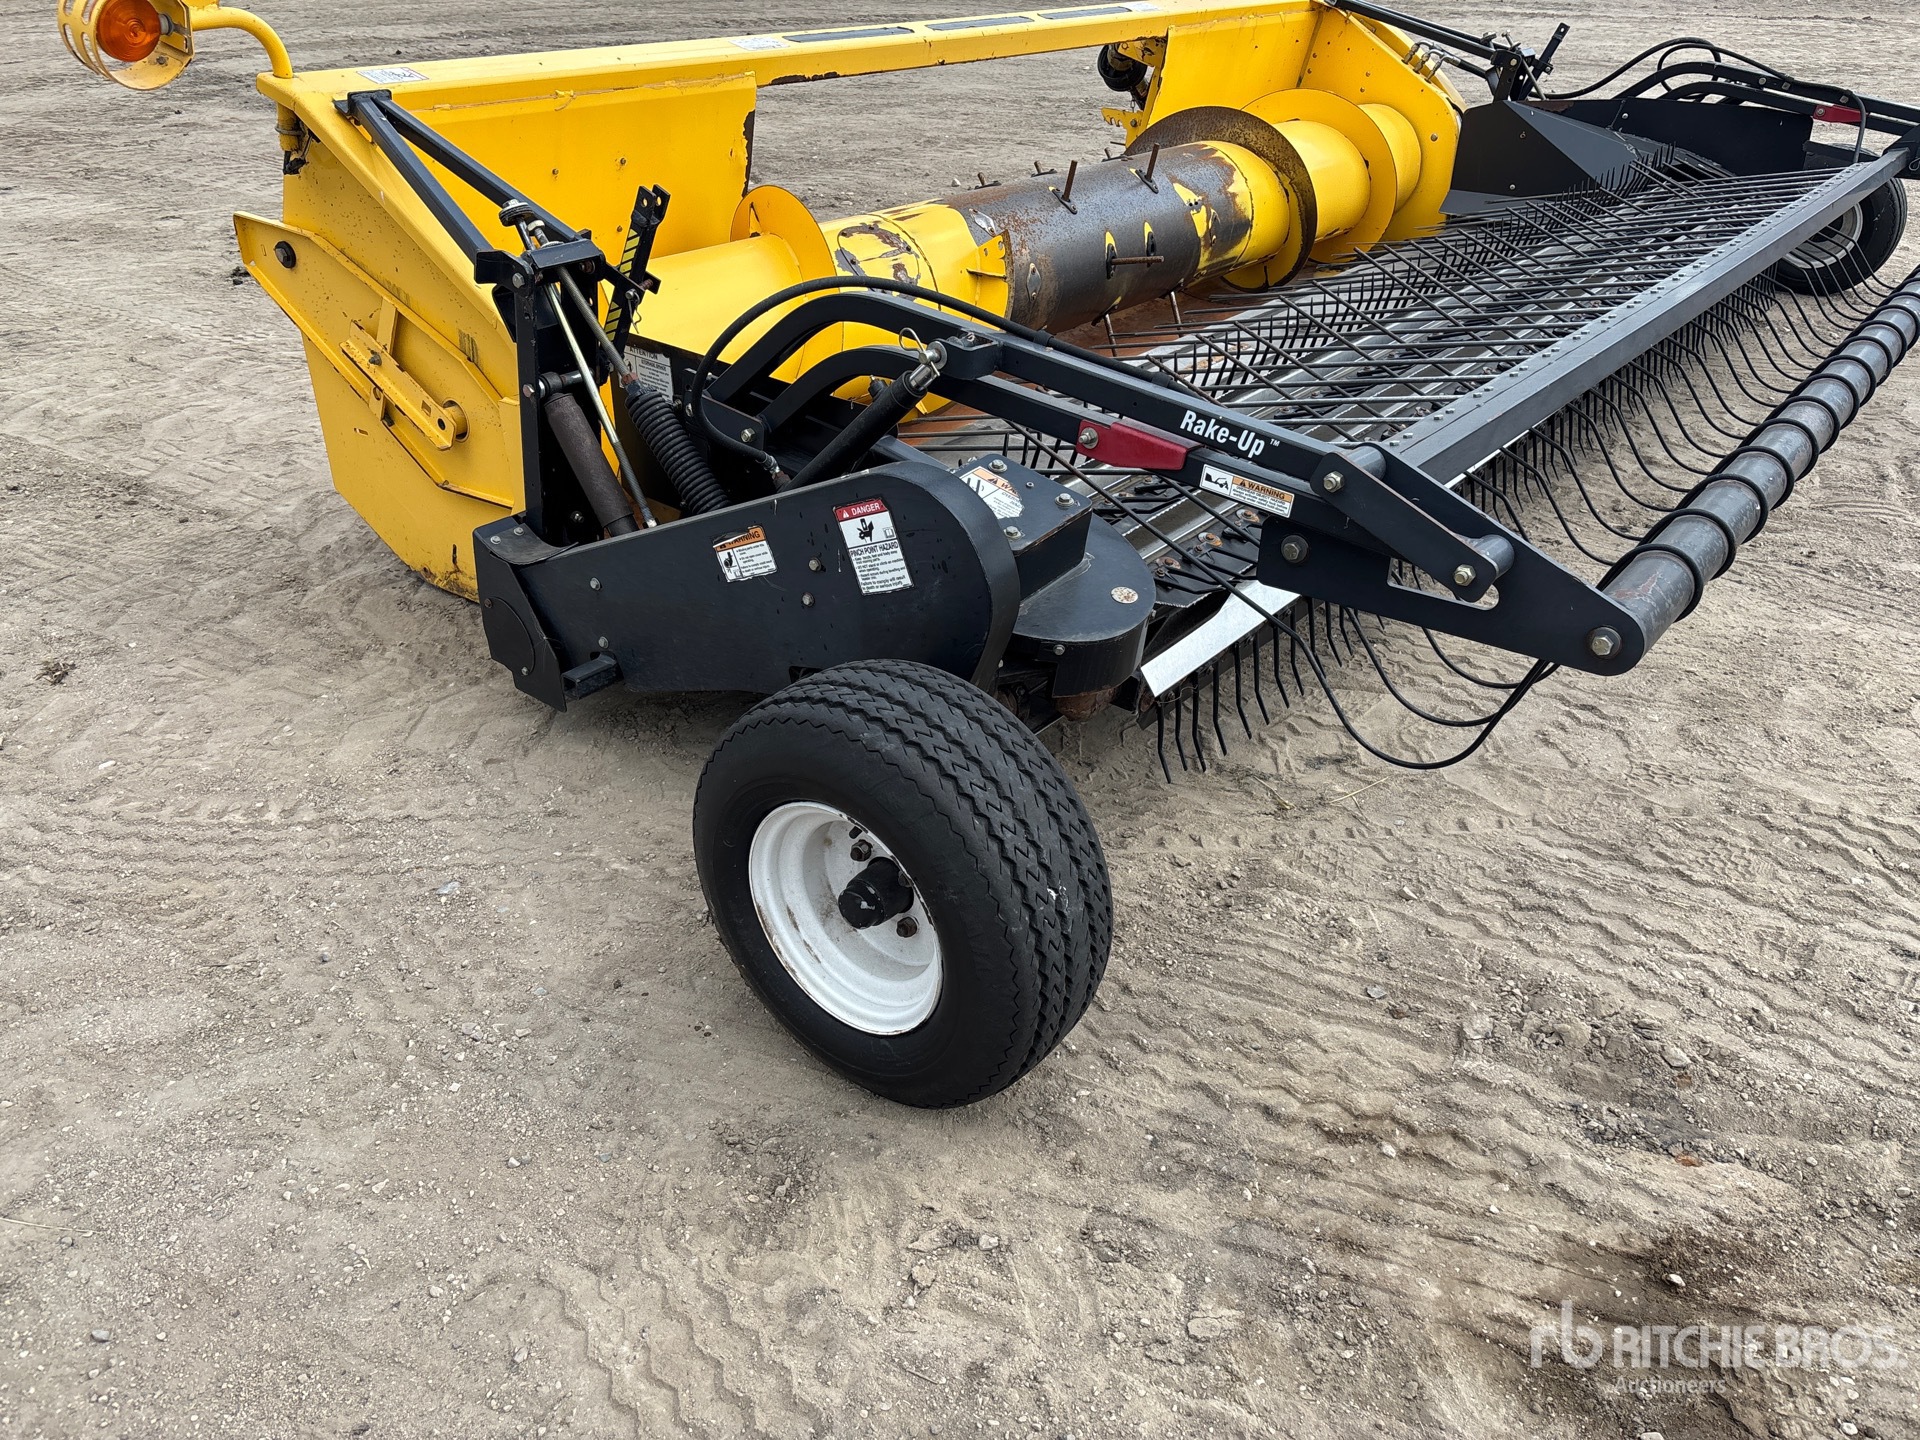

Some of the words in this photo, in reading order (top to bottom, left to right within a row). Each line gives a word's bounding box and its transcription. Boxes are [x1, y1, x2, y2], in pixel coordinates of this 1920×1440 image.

[1180, 410, 1265, 458] Rake-Up
[1248, 481, 1285, 500] WARNING
[850, 502, 881, 516] DANGER
[850, 548, 864, 557] PINCH
[864, 545, 879, 554] POINT
[879, 541, 899, 552] HAZARD
